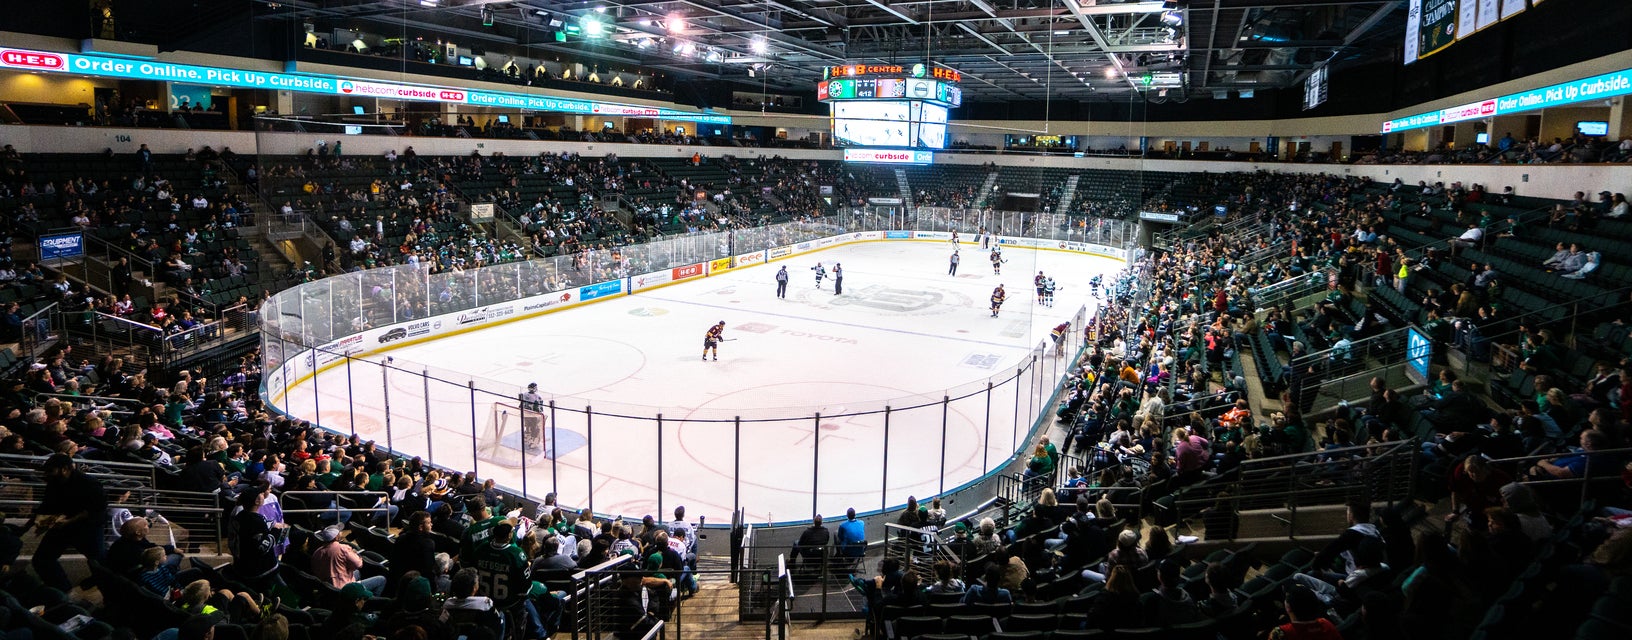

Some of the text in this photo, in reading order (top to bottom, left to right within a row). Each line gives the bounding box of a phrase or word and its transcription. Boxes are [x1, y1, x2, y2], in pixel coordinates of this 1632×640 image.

[7, 53, 57, 66] H-E-B
[75, 57, 333, 90] Order Online. Pick Up Curbside.
[867, 65, 903, 73] CENTER
[1500, 75, 1631, 110] Order Online. Pick Up Curbside.
[471, 93, 590, 111] Order Online. Pick Up Curbside.
[115, 134, 131, 143] 104
[43, 236, 80, 247] EQUIPMENT
[781, 329, 858, 345] TOYOTA
[478, 569, 509, 600] 56
